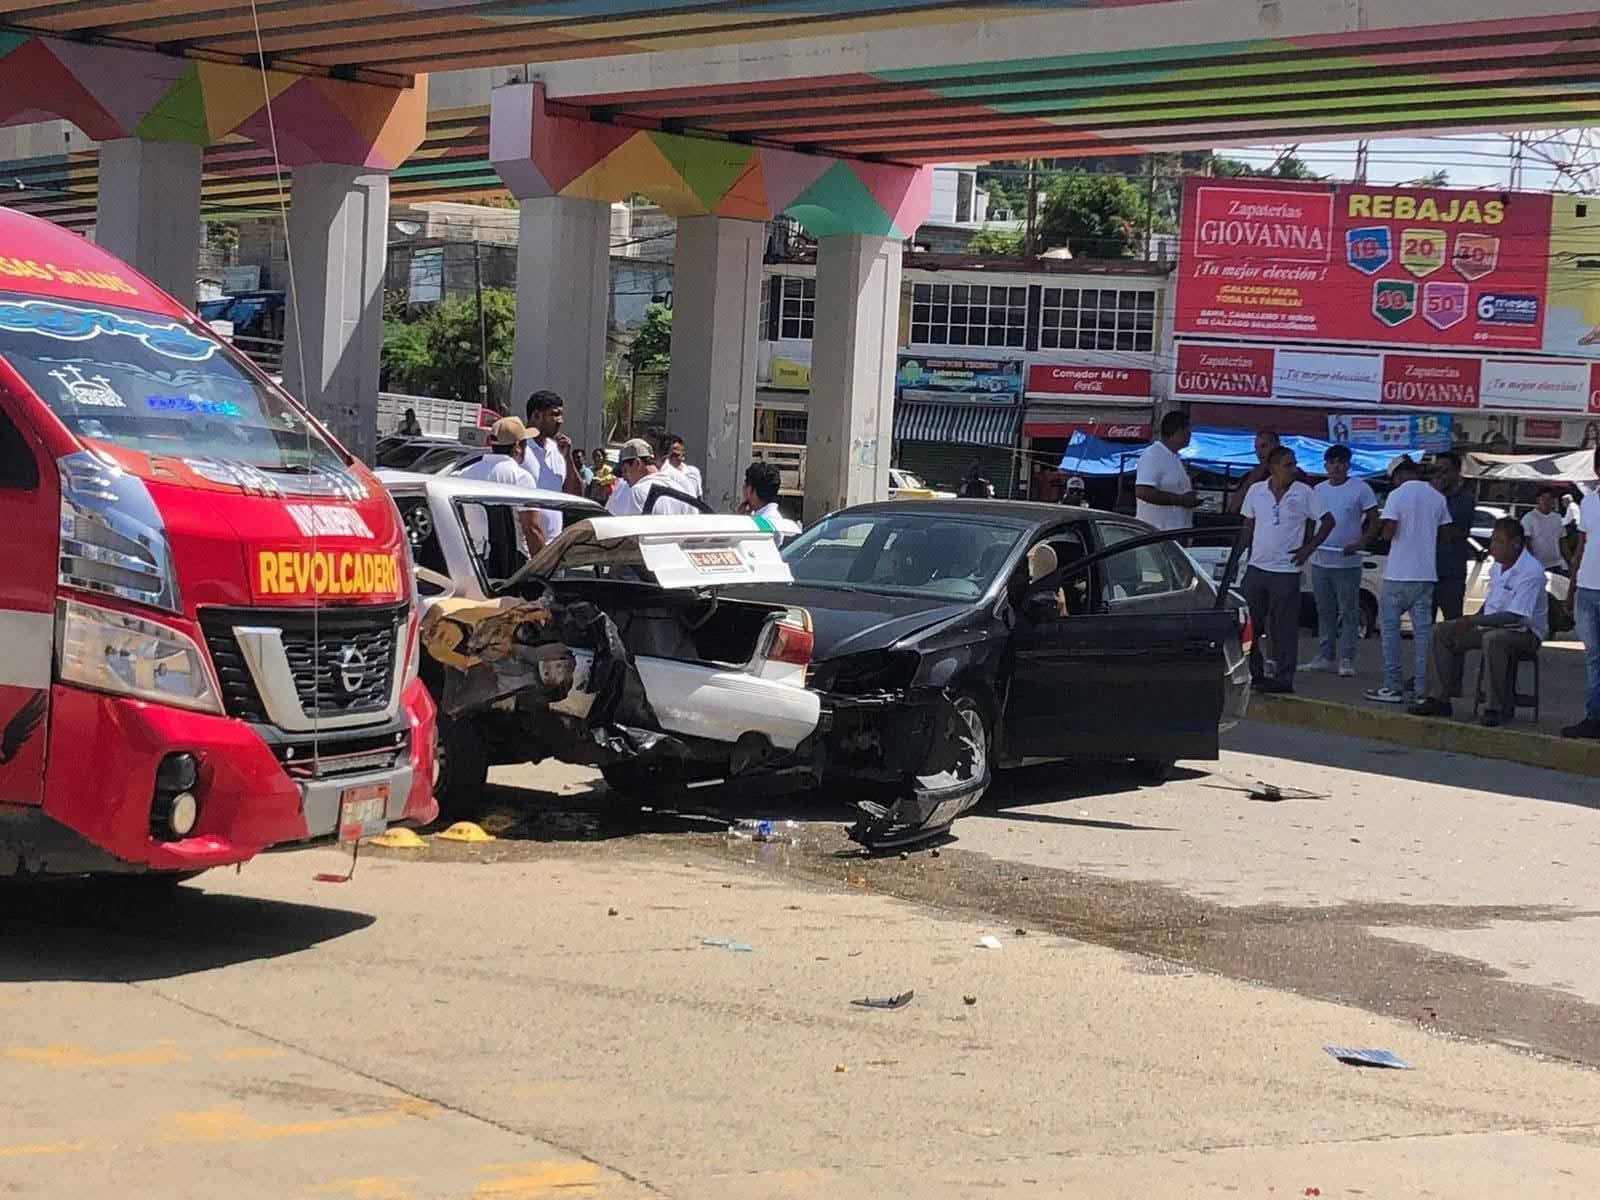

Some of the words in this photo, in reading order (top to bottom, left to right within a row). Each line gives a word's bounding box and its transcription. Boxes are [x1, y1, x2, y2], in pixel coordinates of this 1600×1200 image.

[1228, 200, 1303, 219] Zapaterías
[1348, 194, 1505, 224] REBAJAS
[1201, 220, 1324, 250] GIOVANNA
[1221, 264, 1261, 281] mejor
[1478, 295, 1495, 319] 6
[1052, 368, 1101, 379] Comedor
[1102, 370, 1113, 379] Mi
[1116, 371, 1129, 380] Fe
[1178, 371, 1269, 393] GIOVANNA
[1384, 381, 1476, 403] GIOVANNA
[259, 551, 398, 594] REVOLCADERO
